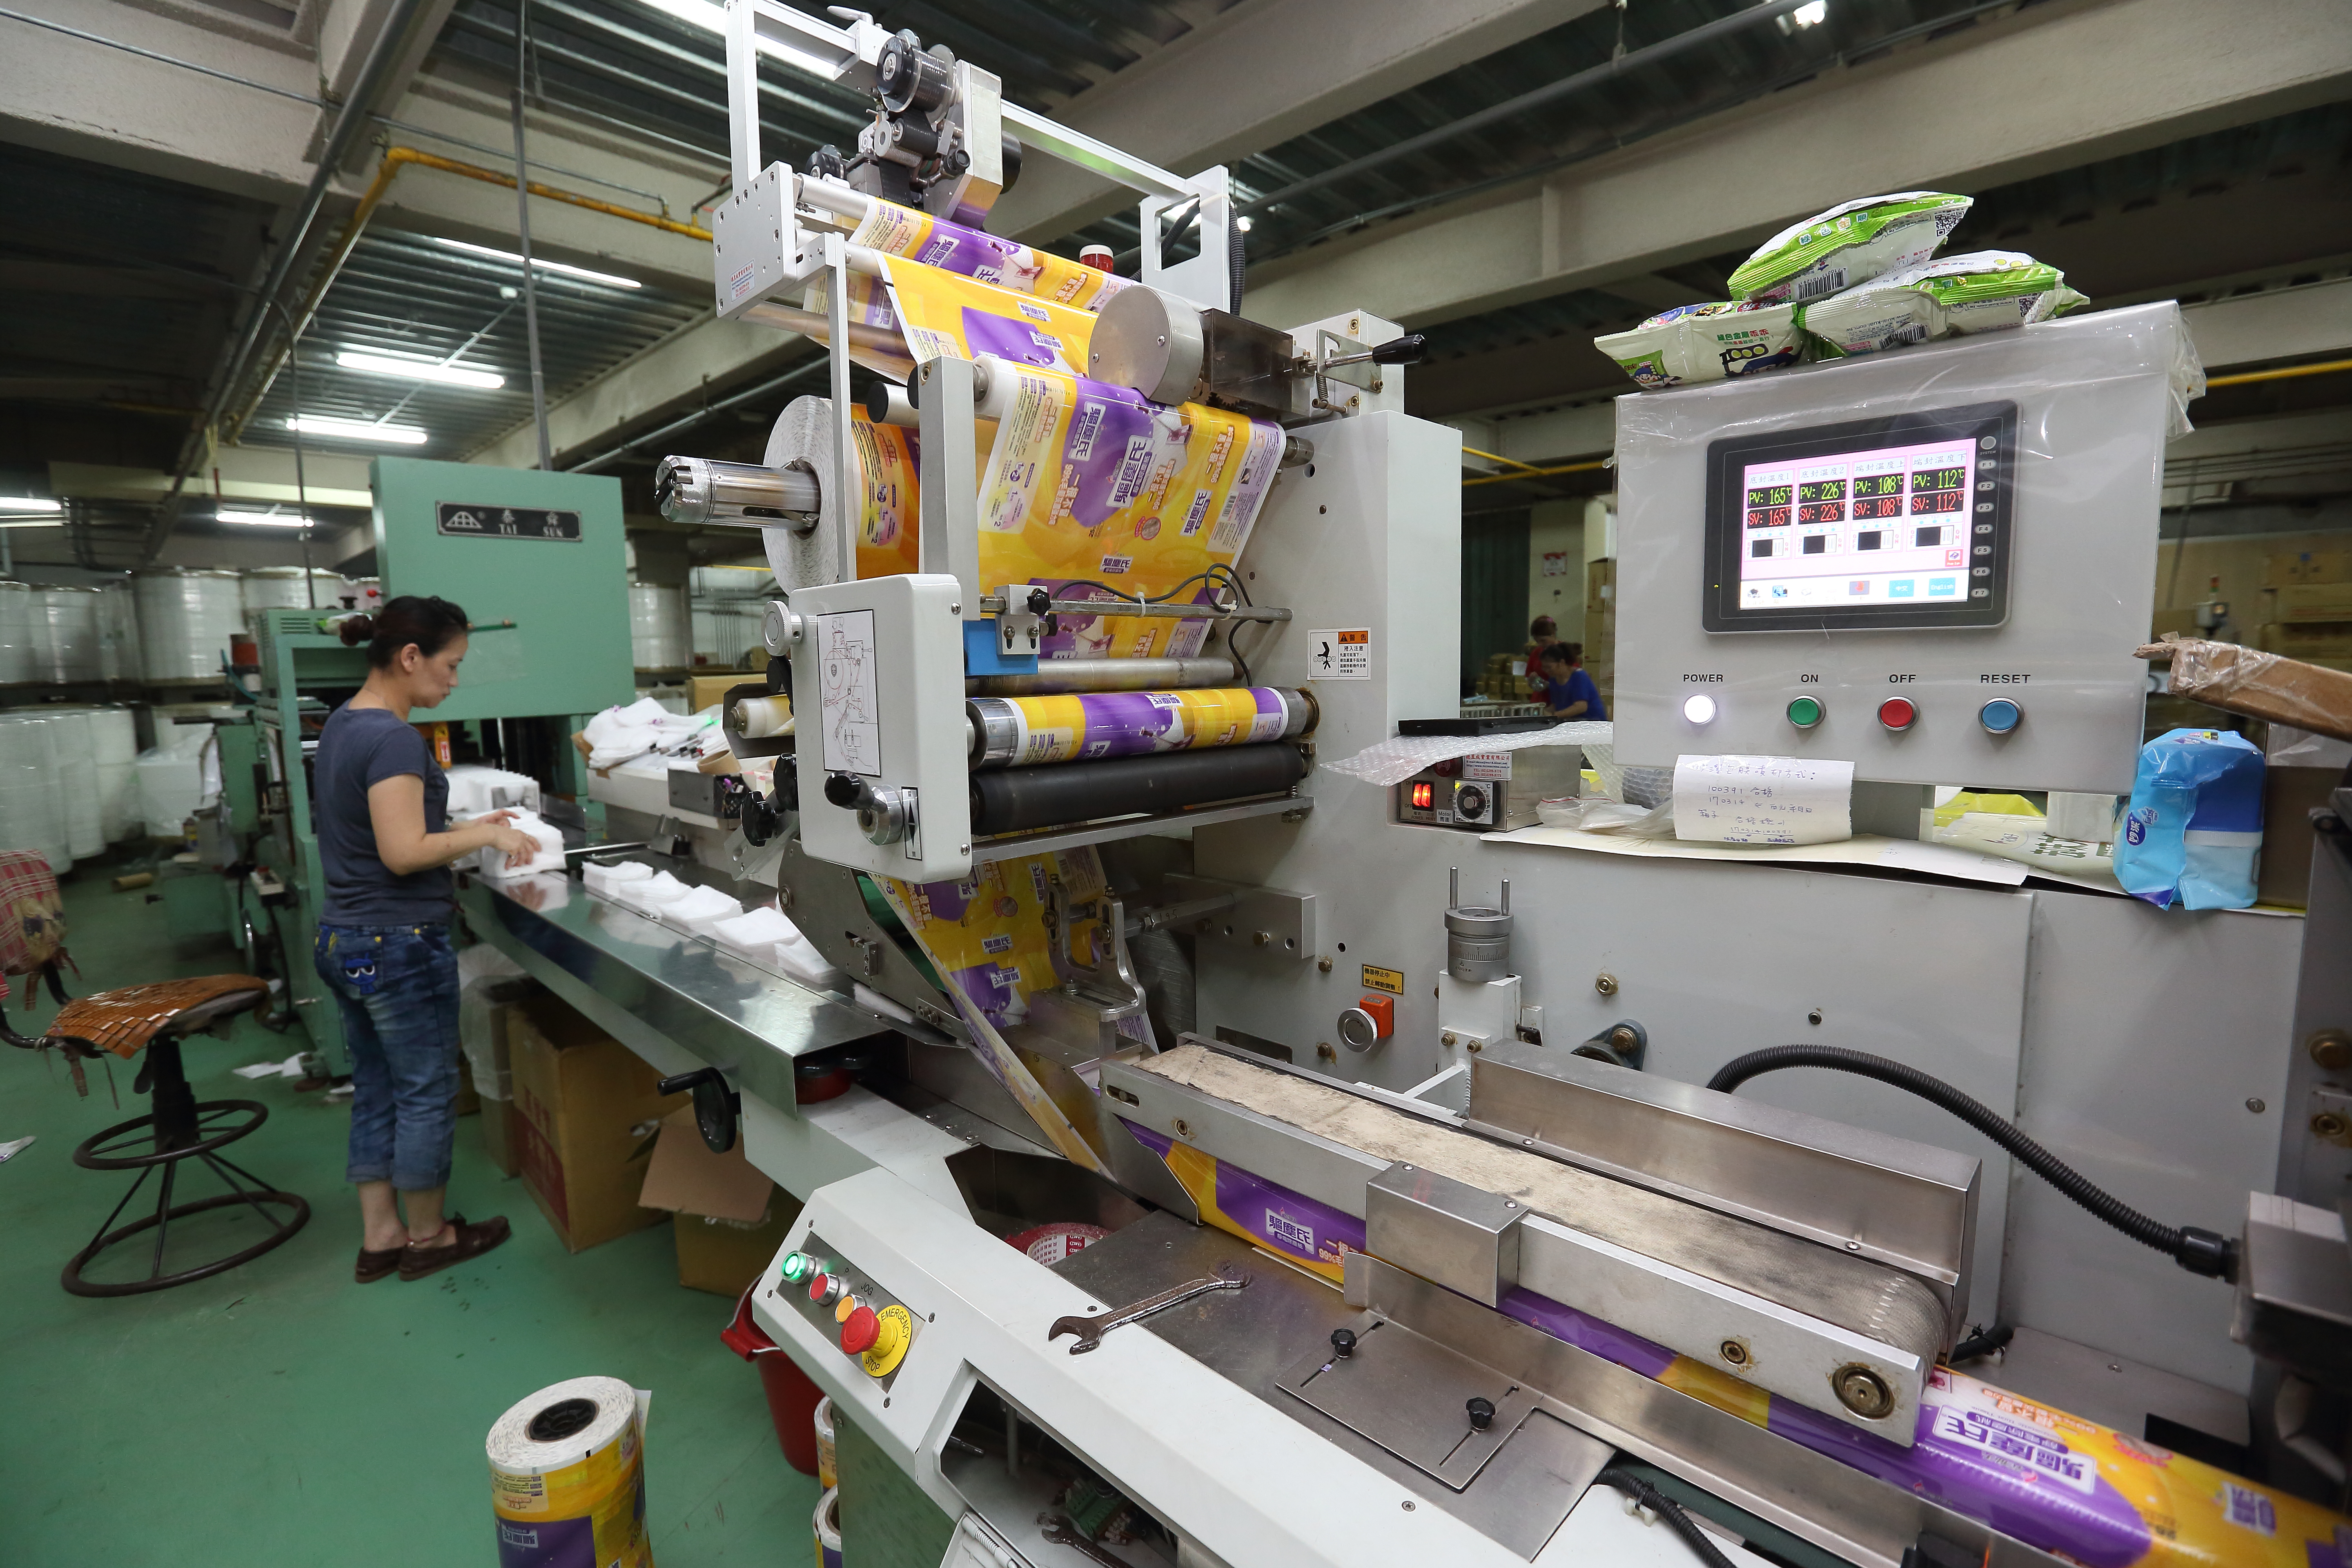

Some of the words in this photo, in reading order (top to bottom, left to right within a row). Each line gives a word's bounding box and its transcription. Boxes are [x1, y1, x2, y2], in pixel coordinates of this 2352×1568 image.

[1855, 460, 1905, 472] 端封溫度上
[1913, 453, 1967, 466] 端封溫度下
[1800, 466, 1844, 479] 底封溫度2
[1855, 480, 1872, 494] PV:
[1913, 474, 1931, 489] PV:
[1748, 491, 1764, 505] PV:
[1800, 486, 1816, 499] PV:
[1854, 502, 1871, 517] SV:
[1912, 497, 1930, 512] SV:
[1748, 512, 1763, 526] SV:
[1799, 508, 1815, 521] SV:
[1895, 534, 1899, 544] ON
[1955, 529, 1960, 540] ON
[1784, 541, 1789, 552] ON
[1838, 538, 1842, 548] ON
[1931, 583, 1955, 592] English
[1683, 674, 1724, 683] POWER
[1800, 674, 1819, 683] ON
[1889, 674, 1916, 684] OFF
[1980, 674, 2031, 684] RESET
[1708, 786, 1743, 795] 100391
[1750, 786, 1773, 797] 合格
[1709, 796, 1745, 805] 170314
[2128, 820, 2141, 844] 妙潔
[1364, 967, 1390, 978] 機器停止中
[1269, 1214, 1311, 1245] 驅塵氏
[1318, 1247, 1344, 1268] 99%毛
[861, 1282, 874, 1296] JOG
[881, 1307, 909, 1339] EMERGENCY
[865, 1356, 880, 1372] STOP
